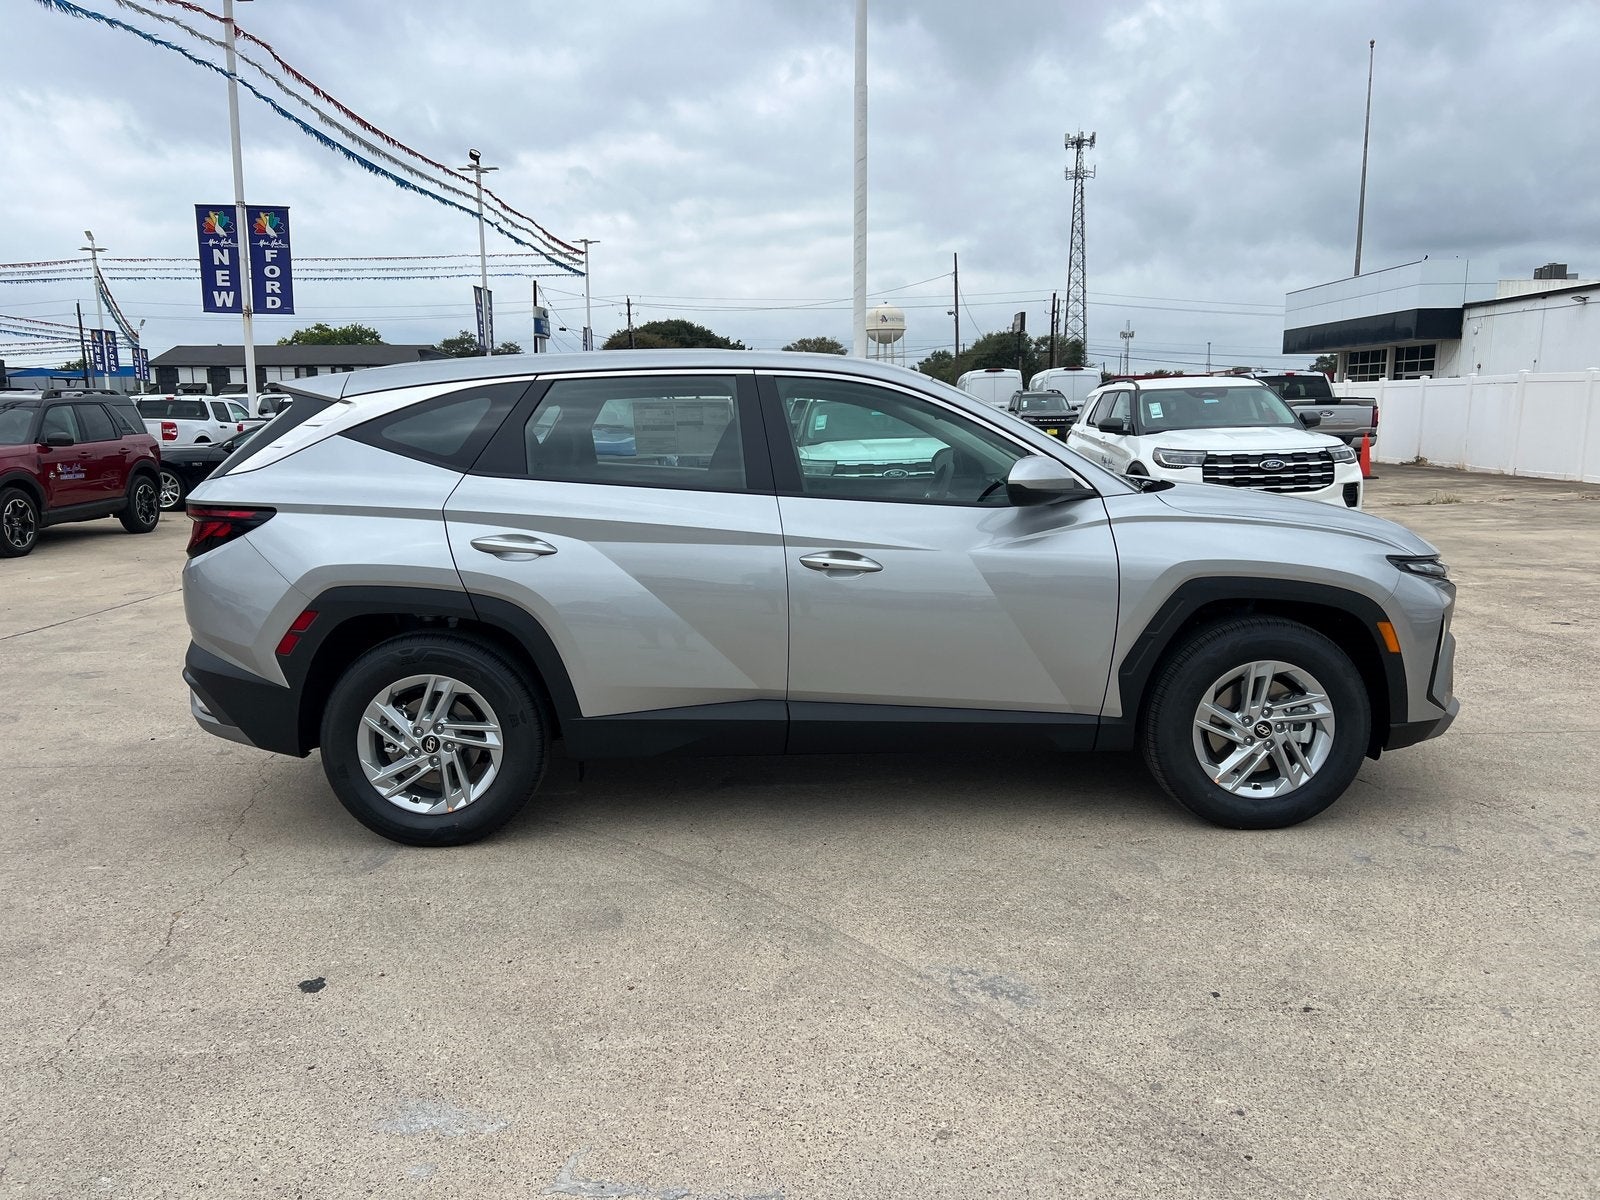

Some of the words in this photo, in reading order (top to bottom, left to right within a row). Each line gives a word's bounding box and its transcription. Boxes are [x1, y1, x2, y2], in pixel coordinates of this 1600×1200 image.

[212, 248, 235, 308] NEW
[264, 249, 282, 309] FORD
[94, 346, 103, 371] NEW
[109, 347, 117, 372] FORD
